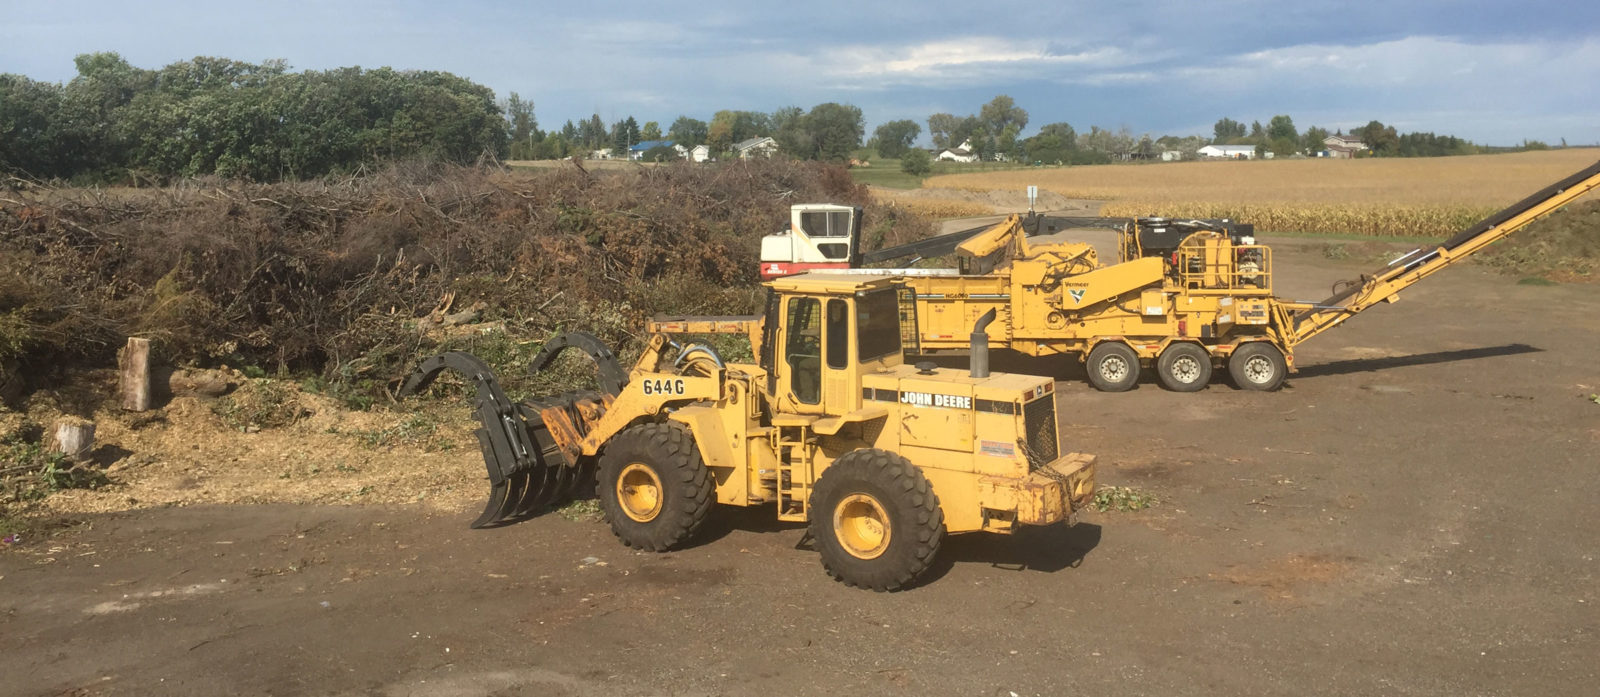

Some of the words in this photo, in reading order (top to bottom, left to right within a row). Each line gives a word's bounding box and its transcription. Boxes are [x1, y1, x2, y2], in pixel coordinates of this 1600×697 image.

[643, 379, 685, 395] 644G
[901, 391, 932, 406] JOHN
[934, 393, 971, 409] DEERE
